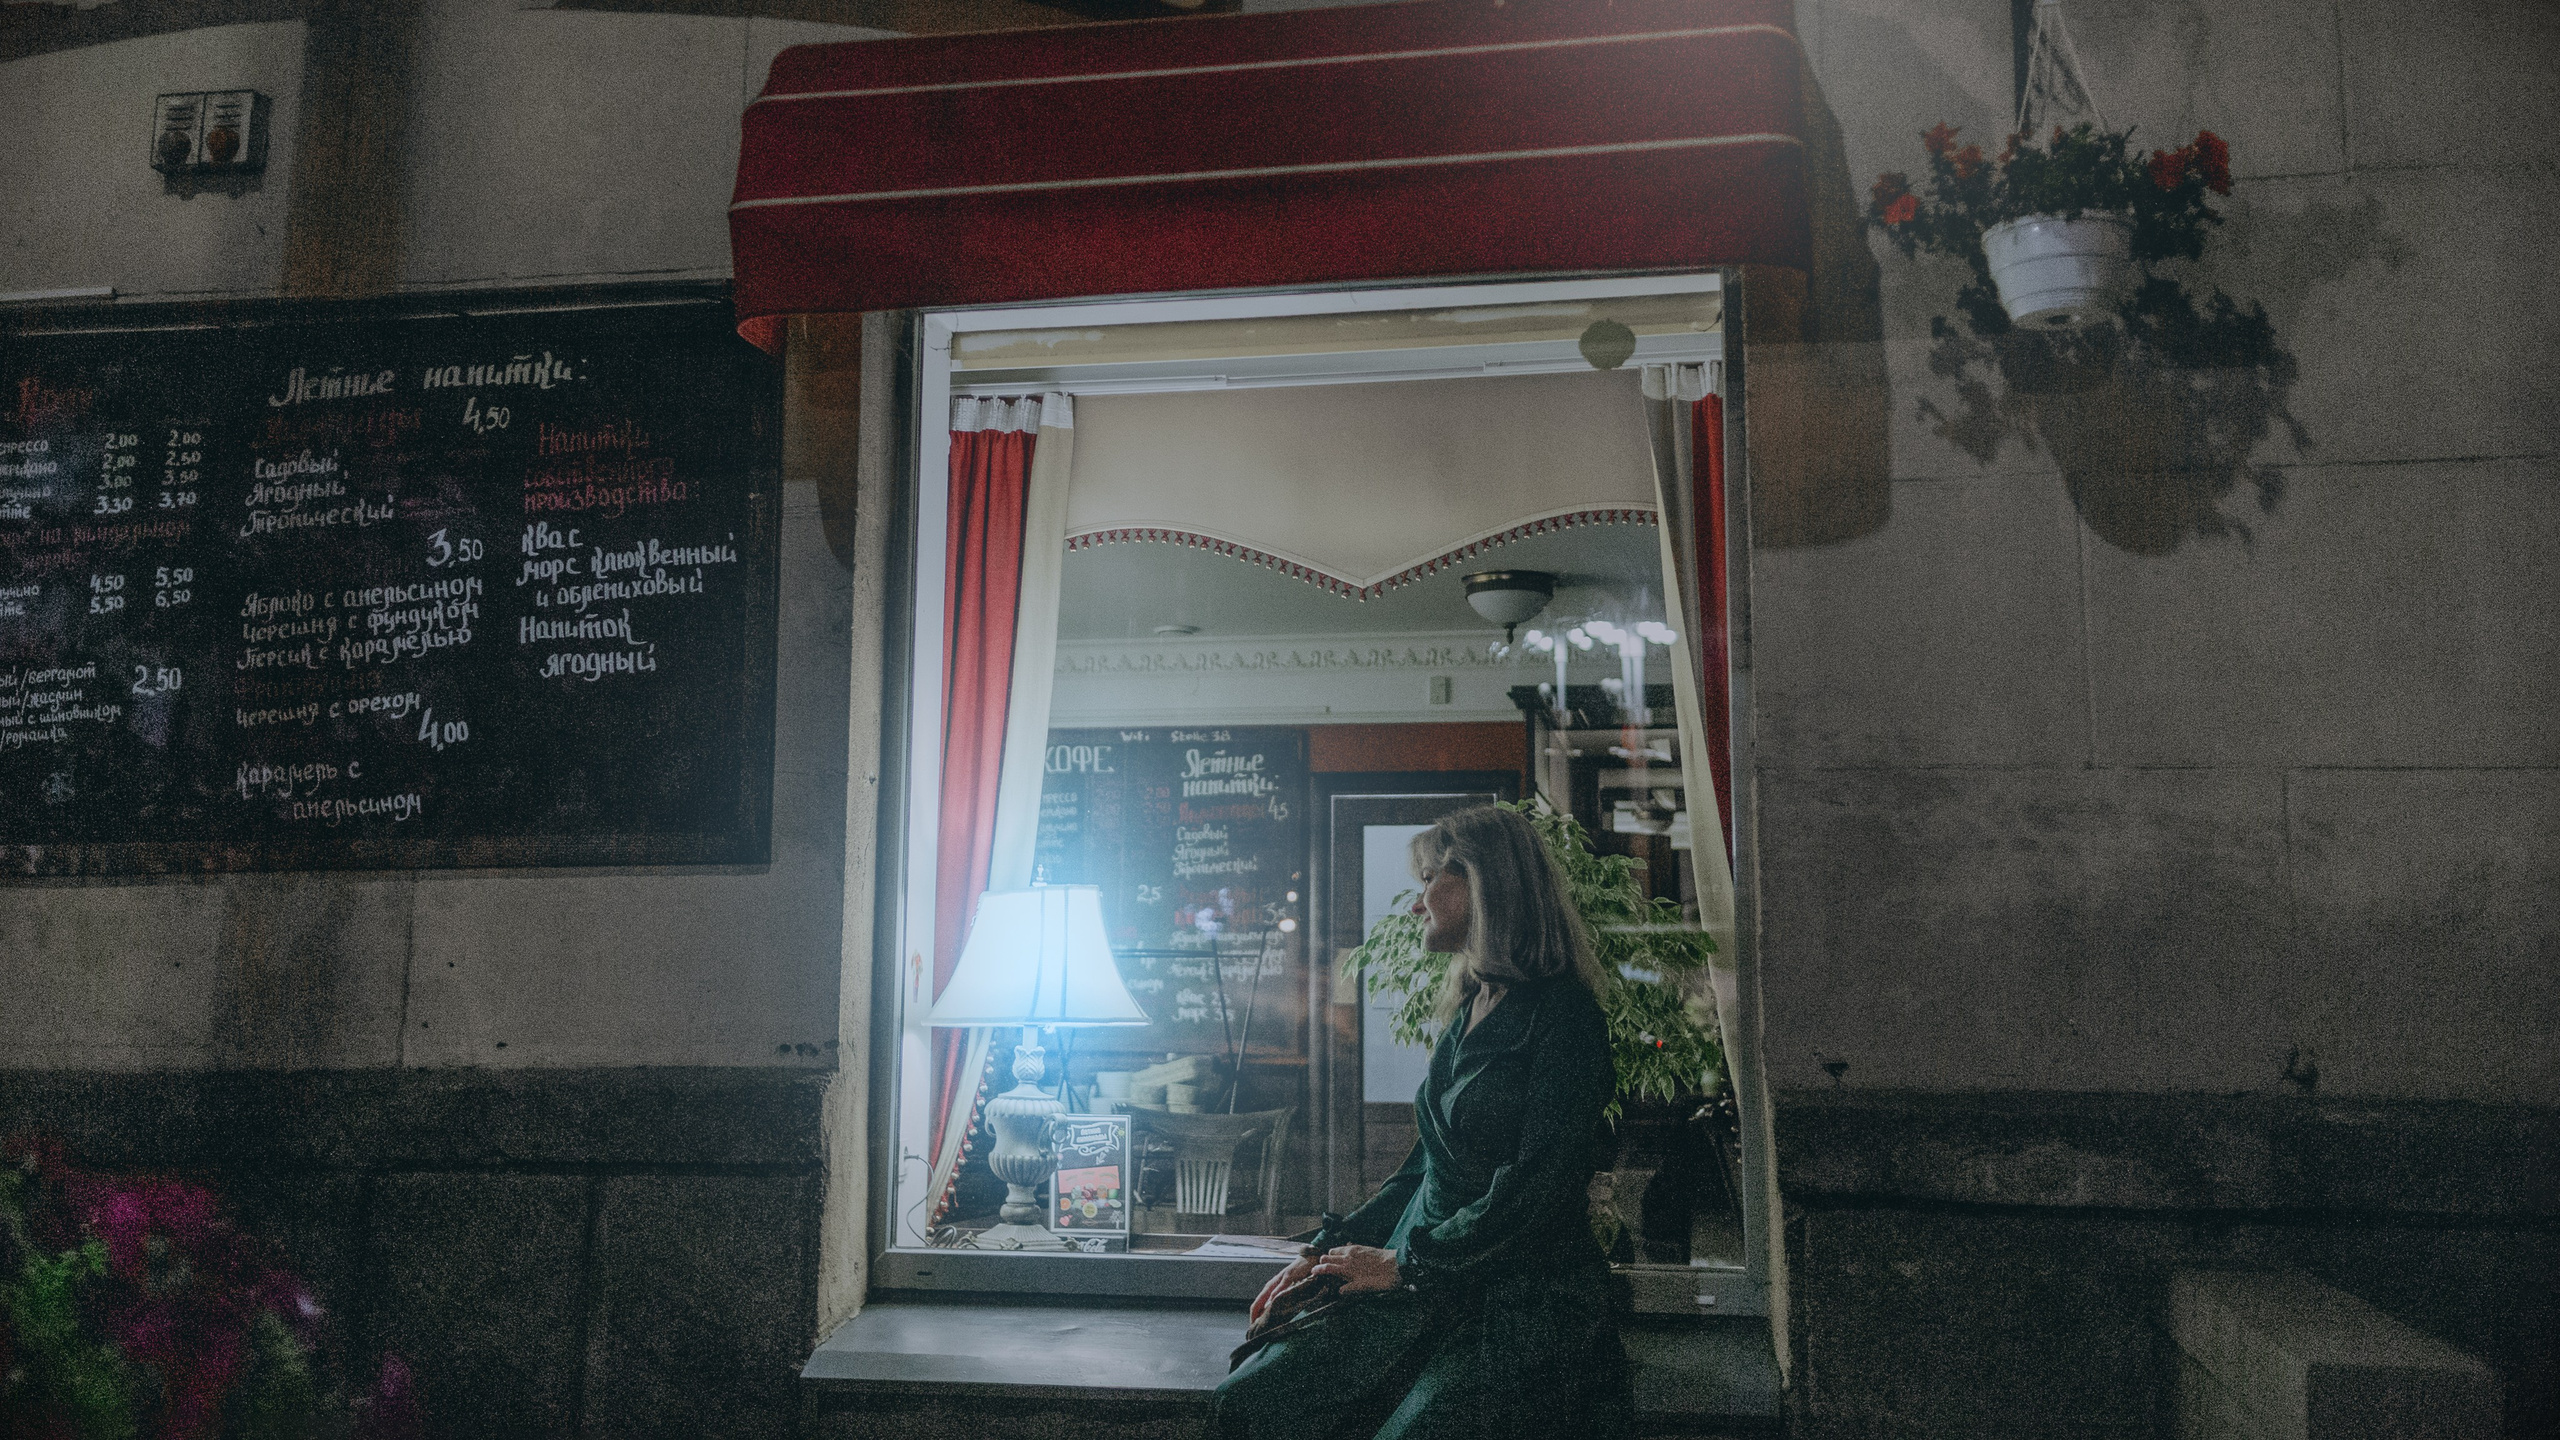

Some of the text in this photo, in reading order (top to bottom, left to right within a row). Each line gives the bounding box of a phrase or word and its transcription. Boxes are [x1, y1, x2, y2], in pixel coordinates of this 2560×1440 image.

[268, 366, 395, 407] Летние
[239, 494, 395, 538] Тропический
[425, 528, 483, 568] 3,50
[418, 707, 469, 751] 4,00
